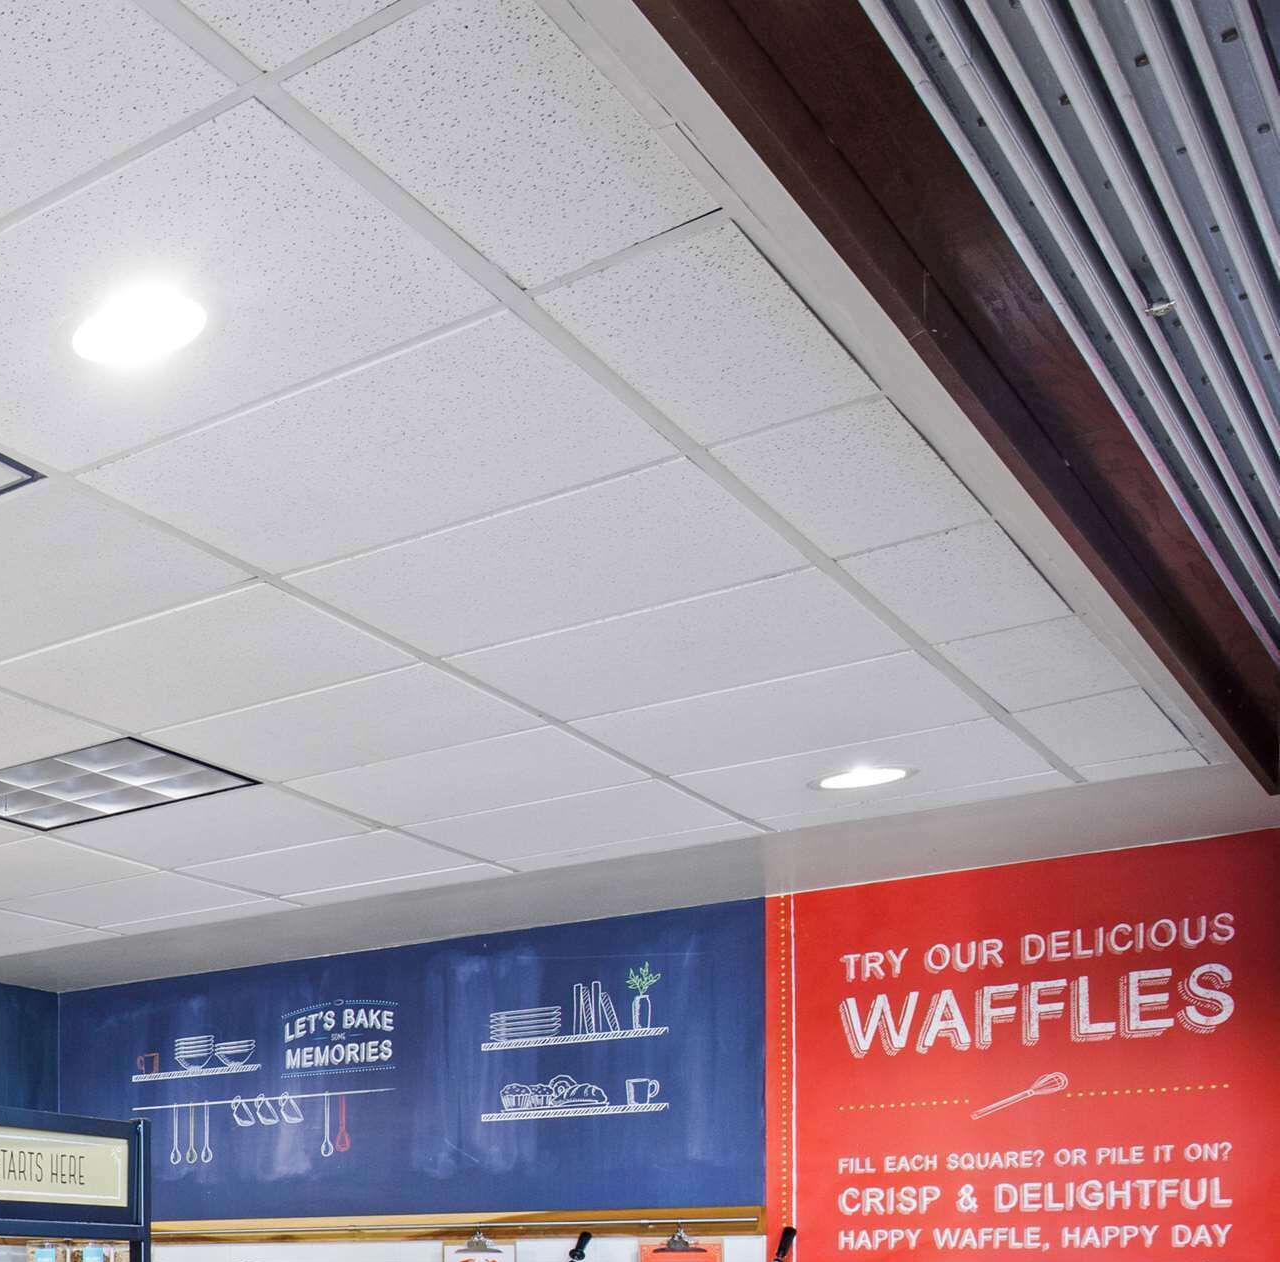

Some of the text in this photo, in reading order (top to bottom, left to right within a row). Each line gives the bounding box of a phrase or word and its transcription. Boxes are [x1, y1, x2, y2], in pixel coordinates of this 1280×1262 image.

[839, 912, 1235, 982] TRY OUR DELICIOUS
[284, 1008, 395, 1043] LET'S BAKE
[838, 962, 1236, 1059] WAFFLES
[285, 1039, 393, 1070] MEMORIES
[50, 1153, 86, 1186] HERE
[838, 1141, 1234, 1175] FILL EACH SQUARE? OR PILE IT ON?
[838, 1177, 1233, 1216] CRISP & DELIGHTFUL
[838, 1223, 1233, 1252] HAPPY WAFFLE, HAPPY DAY
